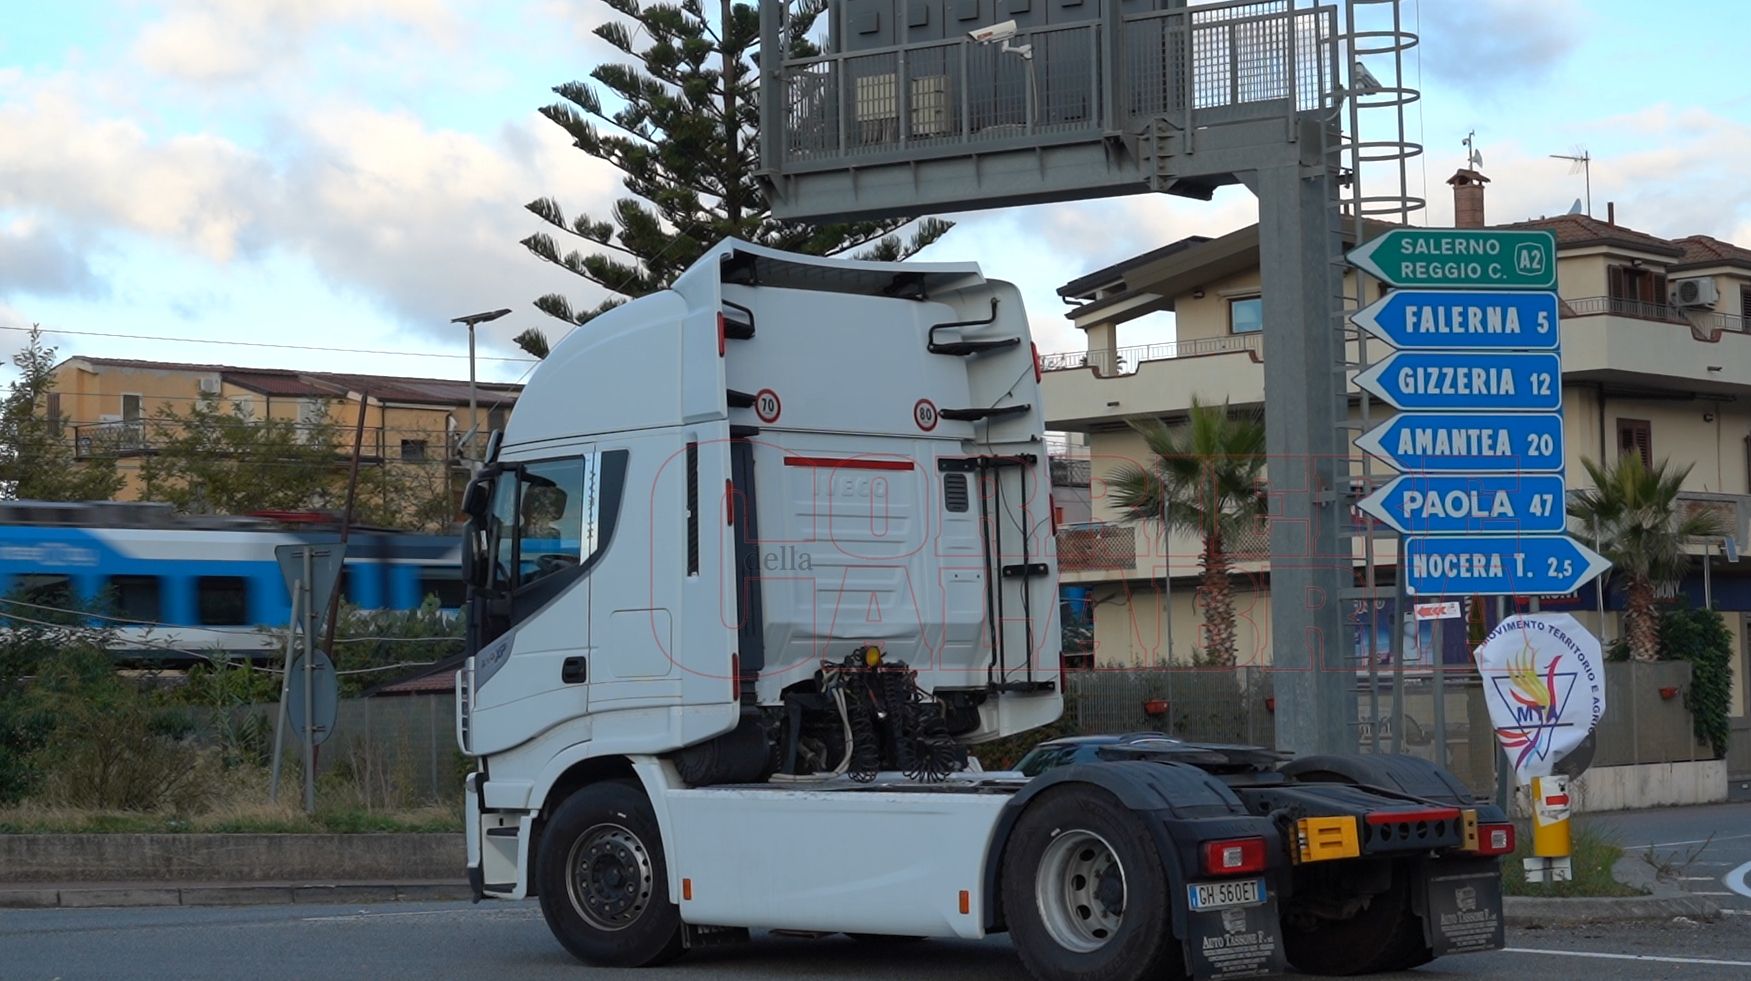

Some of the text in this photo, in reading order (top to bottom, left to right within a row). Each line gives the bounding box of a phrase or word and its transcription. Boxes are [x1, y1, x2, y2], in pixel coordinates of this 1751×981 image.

[1400, 238, 1541, 269] SALERNO A2
[1401, 262, 1507, 279] REGGIO C.
[1405, 305, 1549, 334] FALERNA 5
[1398, 367, 1551, 395] GIZZERIA 12
[761, 398, 775, 412] 70
[919, 407, 932, 421] 80
[1397, 428, 1553, 456] AMANTEA 20
[1403, 490, 1554, 518] PAOLA 47
[1413, 553, 1573, 580] NOCERA T. 2,5
[1549, 624, 1595, 682] TERRITORIO
[1591, 684, 1600, 693] E
[1199, 882, 1256, 905] GH 560ET
